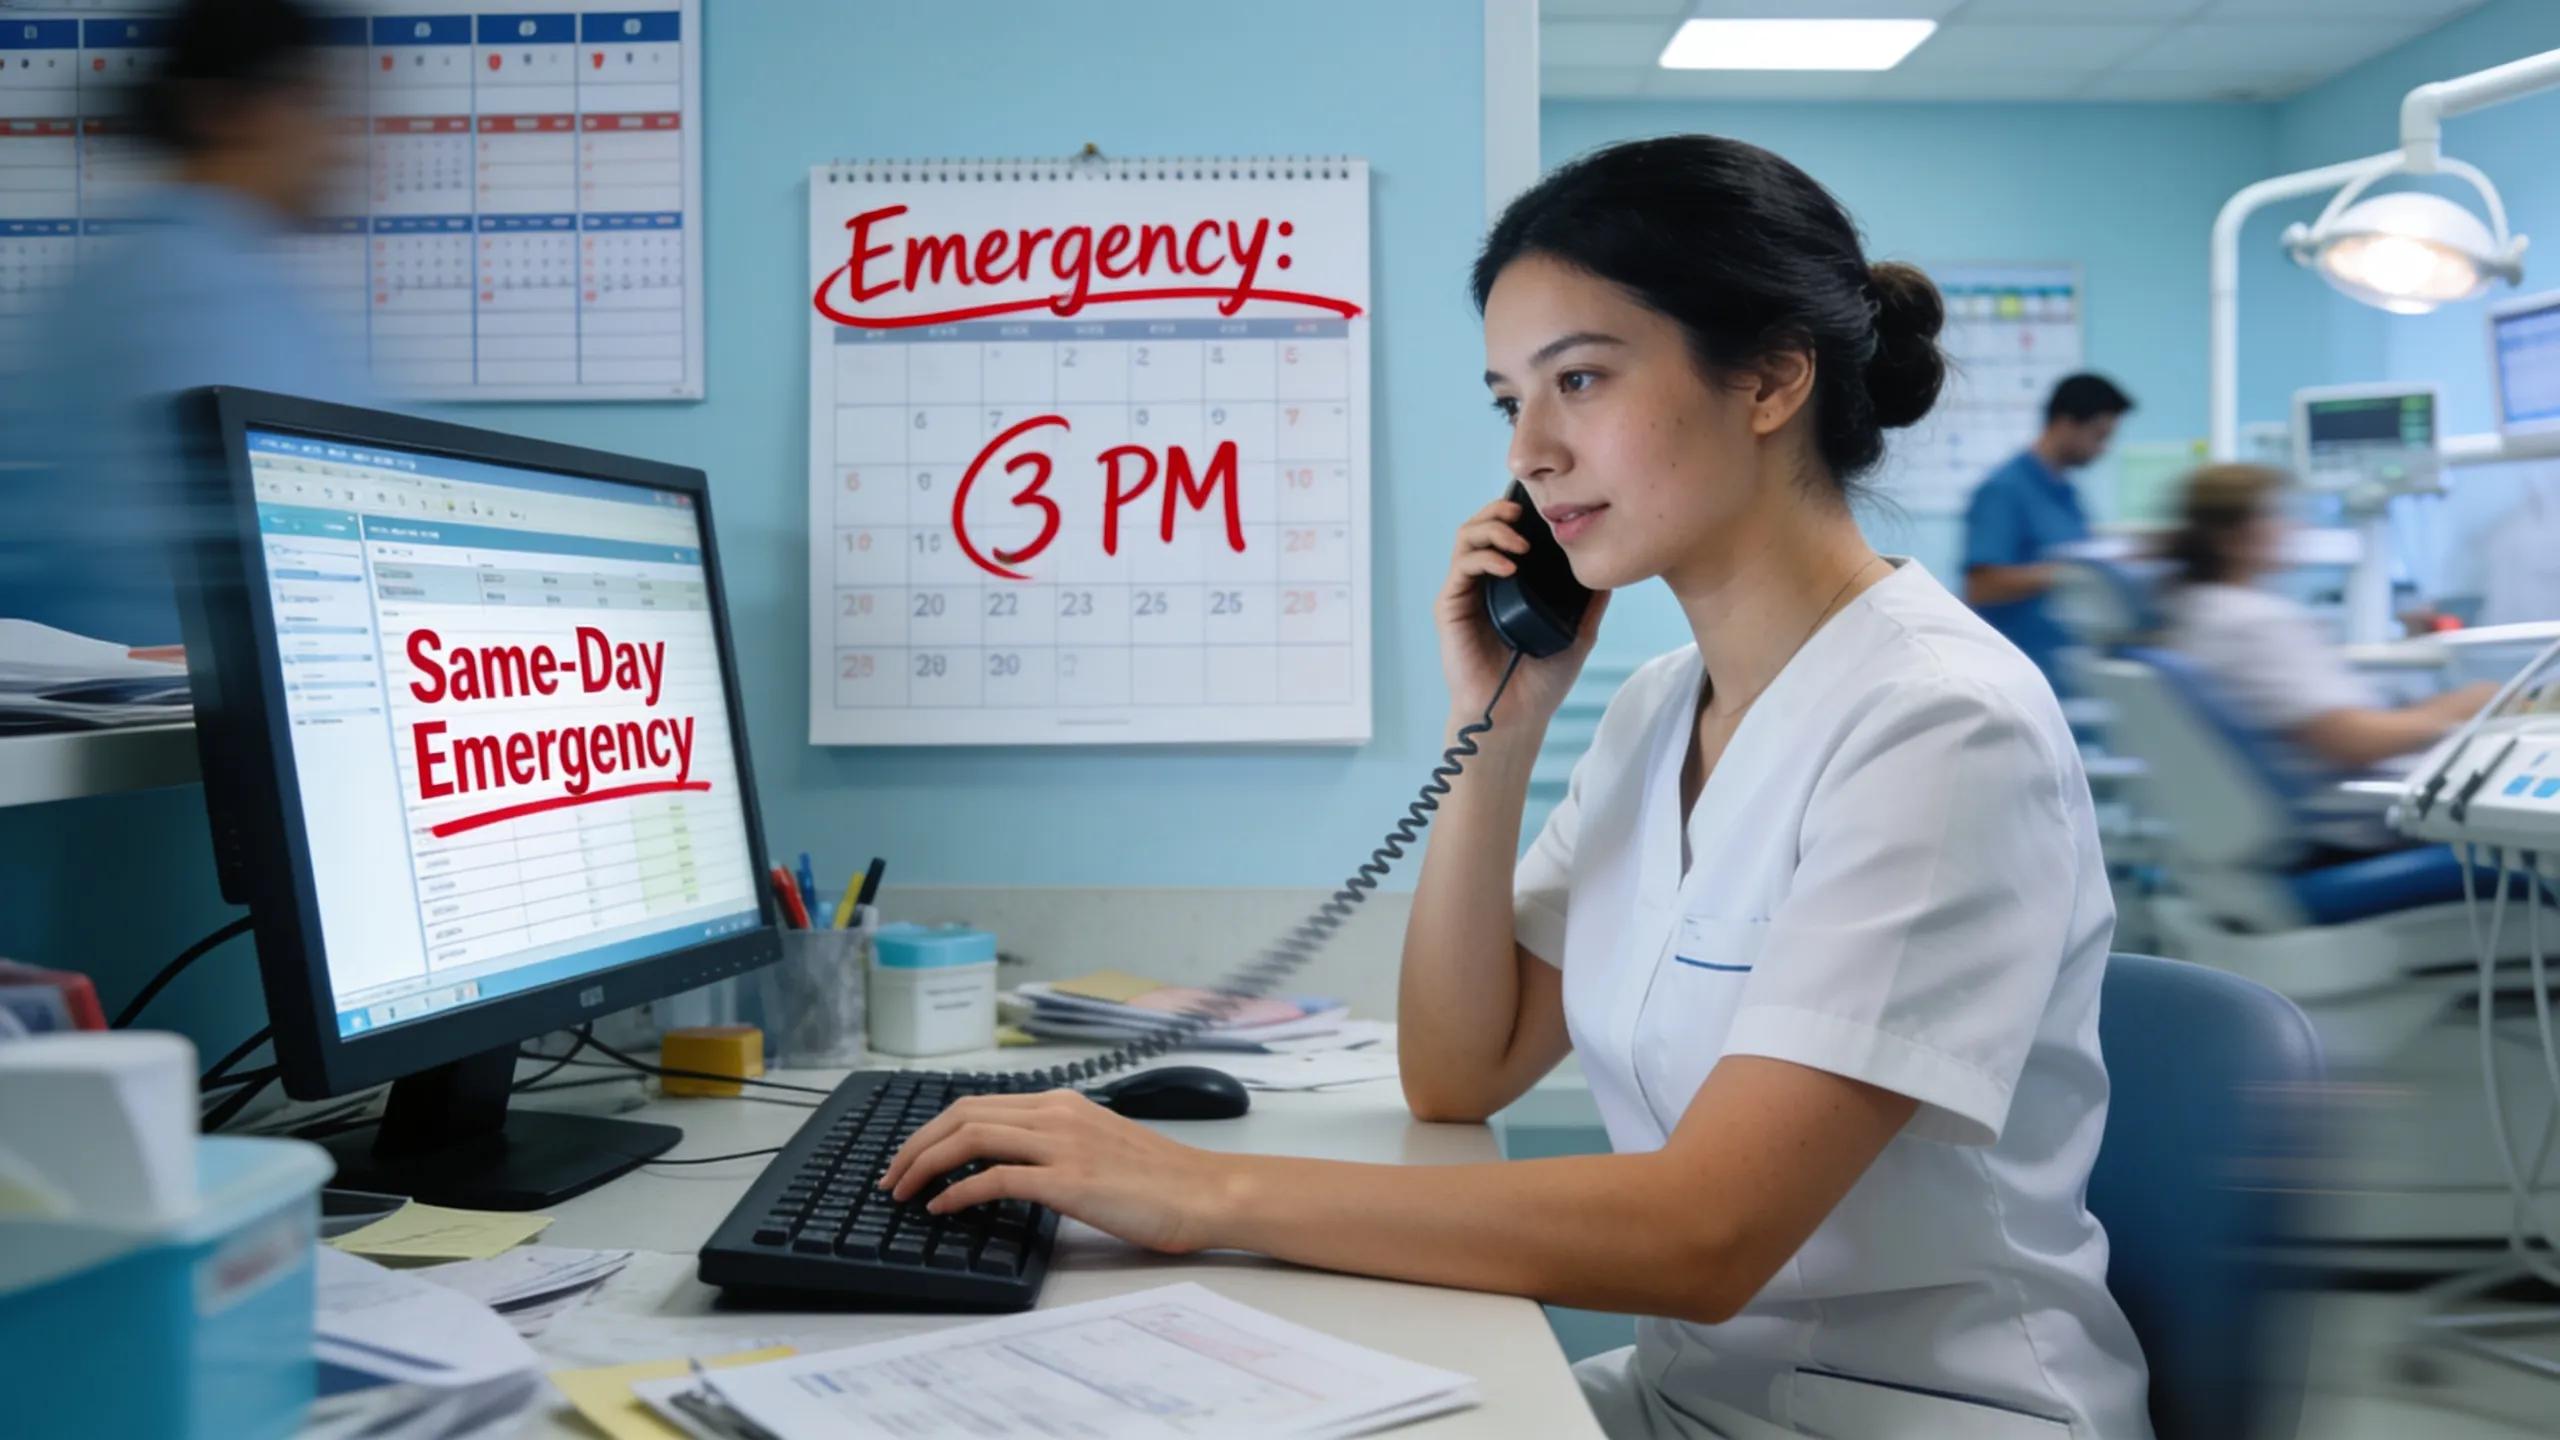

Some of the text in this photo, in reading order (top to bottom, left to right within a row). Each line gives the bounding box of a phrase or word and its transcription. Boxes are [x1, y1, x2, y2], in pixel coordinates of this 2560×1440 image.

[844, 204, 1294, 317] Emergency:
[993, 440, 1246, 564] 3 PM
[406, 626, 664, 707] Same-Day
[412, 716, 694, 799] Emergency
